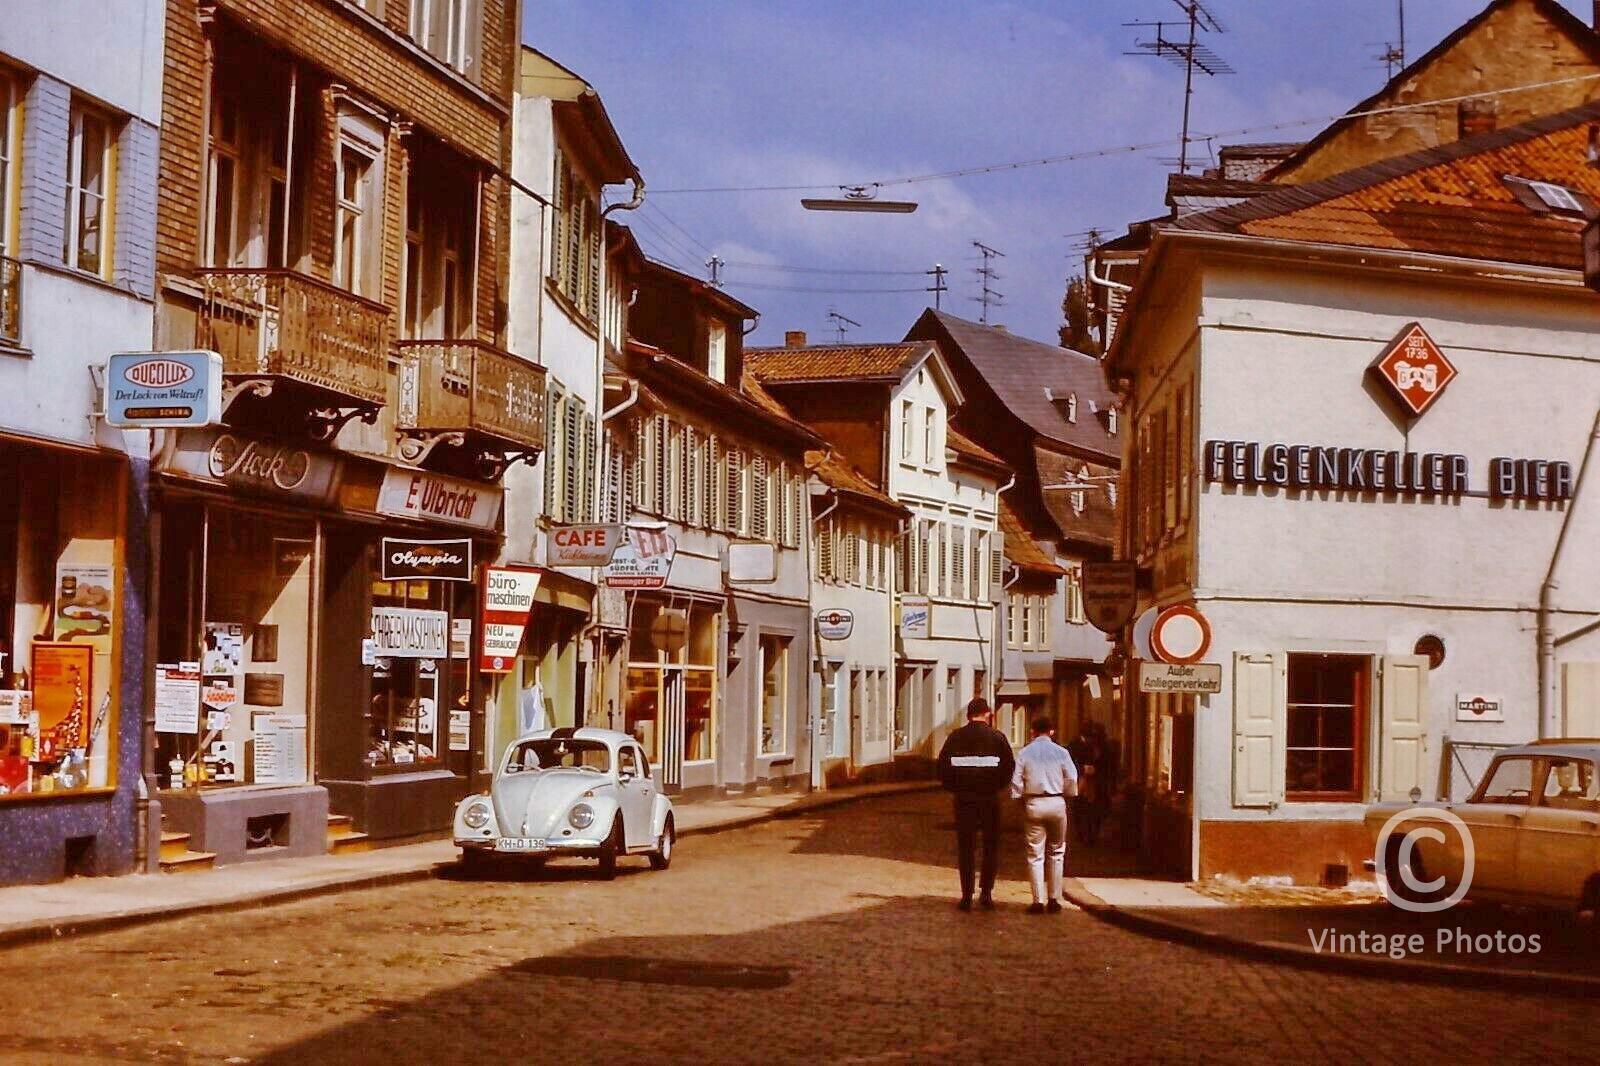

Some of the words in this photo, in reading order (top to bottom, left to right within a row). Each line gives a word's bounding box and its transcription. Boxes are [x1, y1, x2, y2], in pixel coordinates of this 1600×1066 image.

[1408, 336, 1425, 347] SEIT
[1405, 348, 1428, 360] 1736
[132, 363, 188, 384] DUCOLUX
[116, 390, 131, 400] Der
[133, 389, 151, 400] Lack
[1205, 440, 1469, 493] FELSENKELLER
[1490, 457, 1573, 499] BIER
[421, 479, 478, 519] Ulbricht
[391, 550, 463, 568] Olympia
[608, 577, 644, 587] Henninger
[646, 577, 661, 586] Bier
[487, 590, 531, 606] maschinen
[486, 625, 504, 637] NEU
[485, 638, 518, 650] GEBRAUCHT
[1167, 665, 1195, 676] Außer
[1144, 676, 1218, 690] Anliegerverkehr
[1459, 702, 1498, 710] MARTINI
[528, 839, 545, 849] 139
